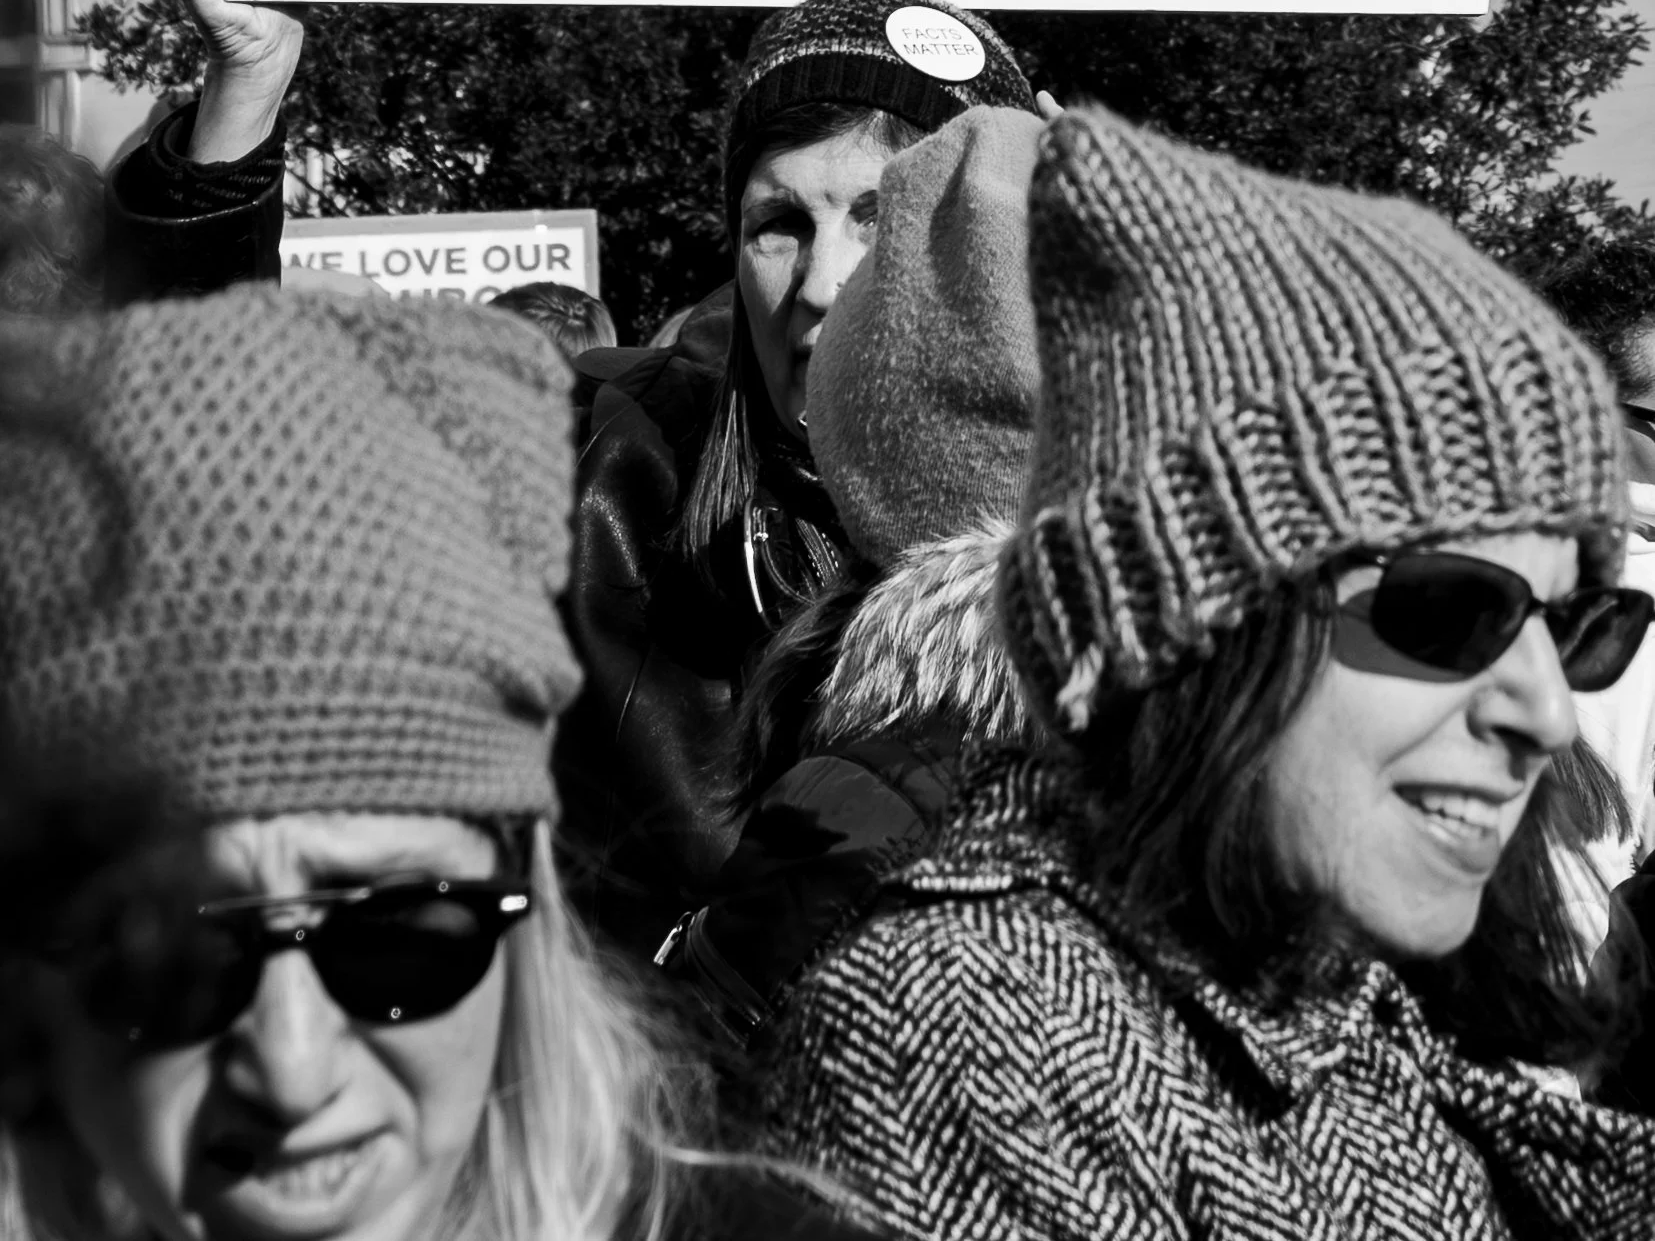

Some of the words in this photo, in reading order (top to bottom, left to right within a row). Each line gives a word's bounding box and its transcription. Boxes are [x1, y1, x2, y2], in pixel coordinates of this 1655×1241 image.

[902, 28, 962, 40] FACTS
[904, 44, 979, 56] MATTER
[359, 248, 467, 277] LOVE
[483, 243, 571, 273] OUR
